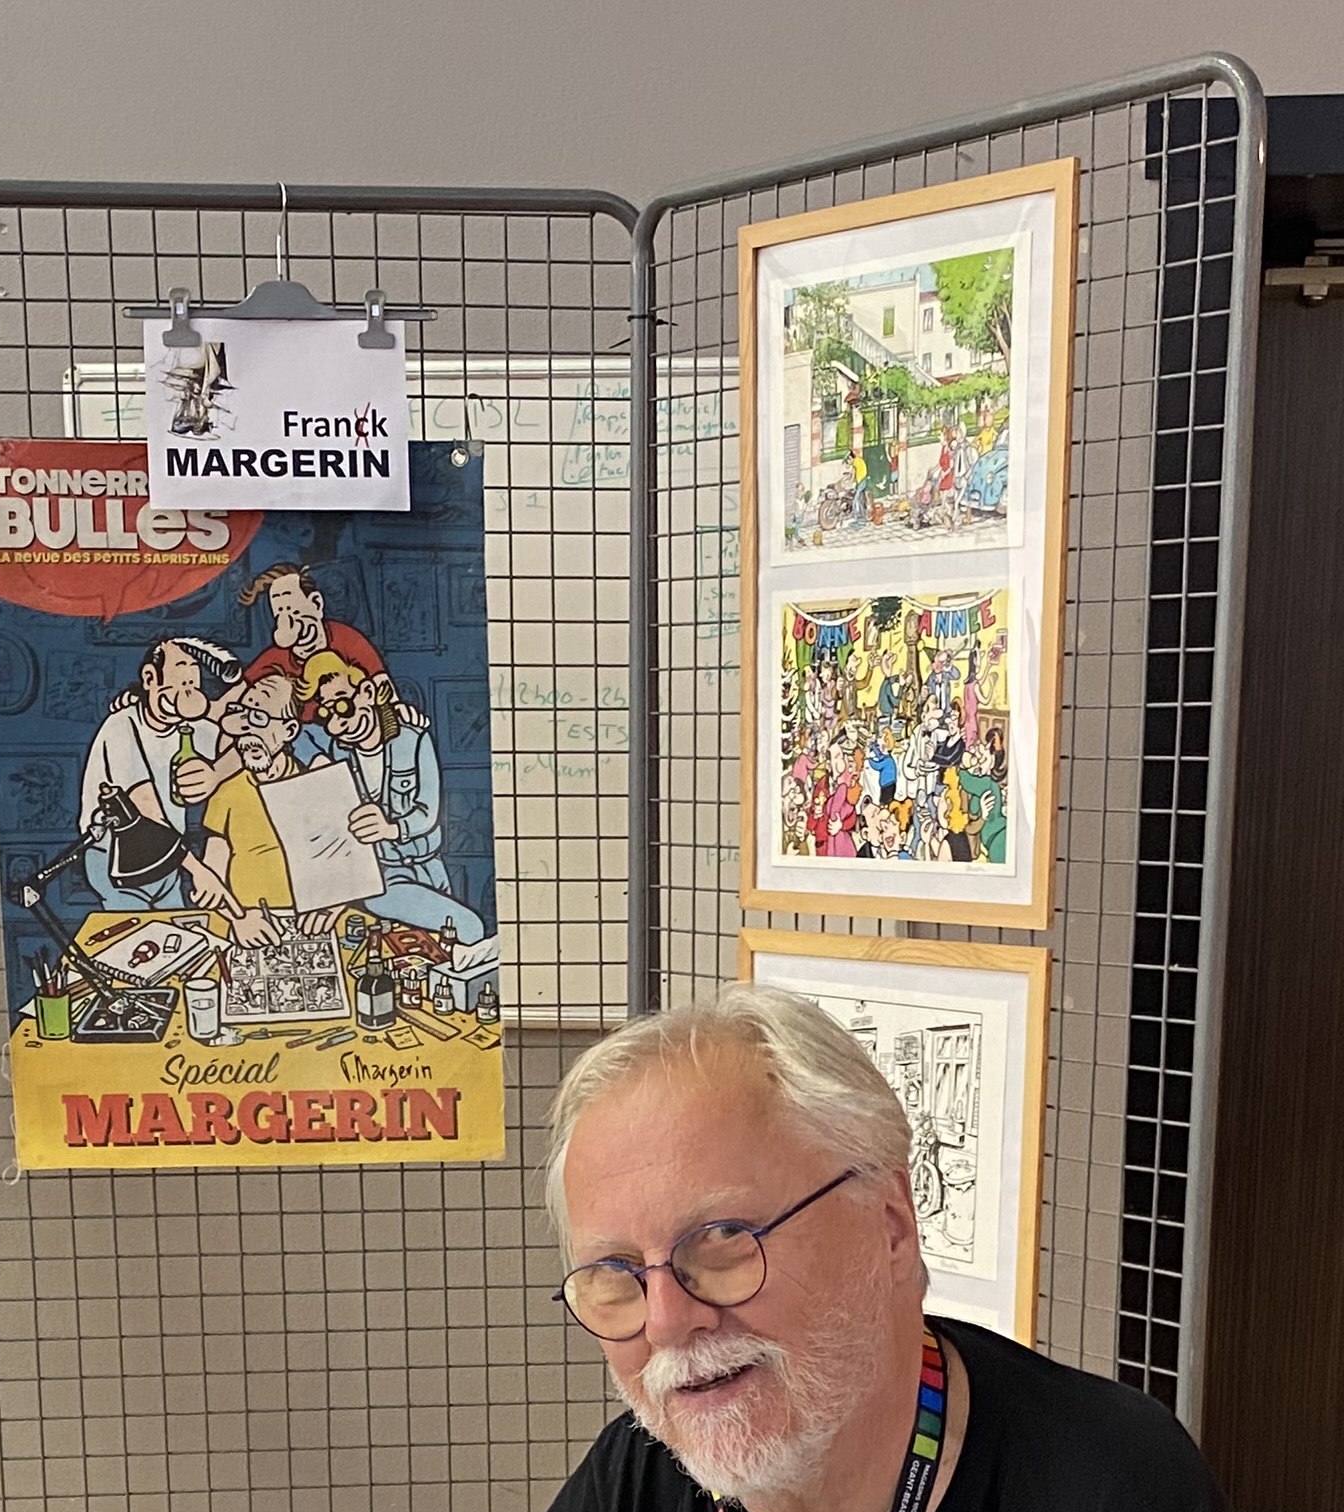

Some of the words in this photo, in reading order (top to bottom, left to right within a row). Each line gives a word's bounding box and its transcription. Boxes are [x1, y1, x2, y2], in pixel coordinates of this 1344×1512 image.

[282, 410, 388, 438] Franck
[166, 447, 391, 478] MARGERIN
[144, 554, 230, 565] SAPRISTAINS
[792, 611, 861, 648] BONNE
[159, 1051, 281, 1094] Spécial
[62, 1087, 463, 1147] MARGERIN
